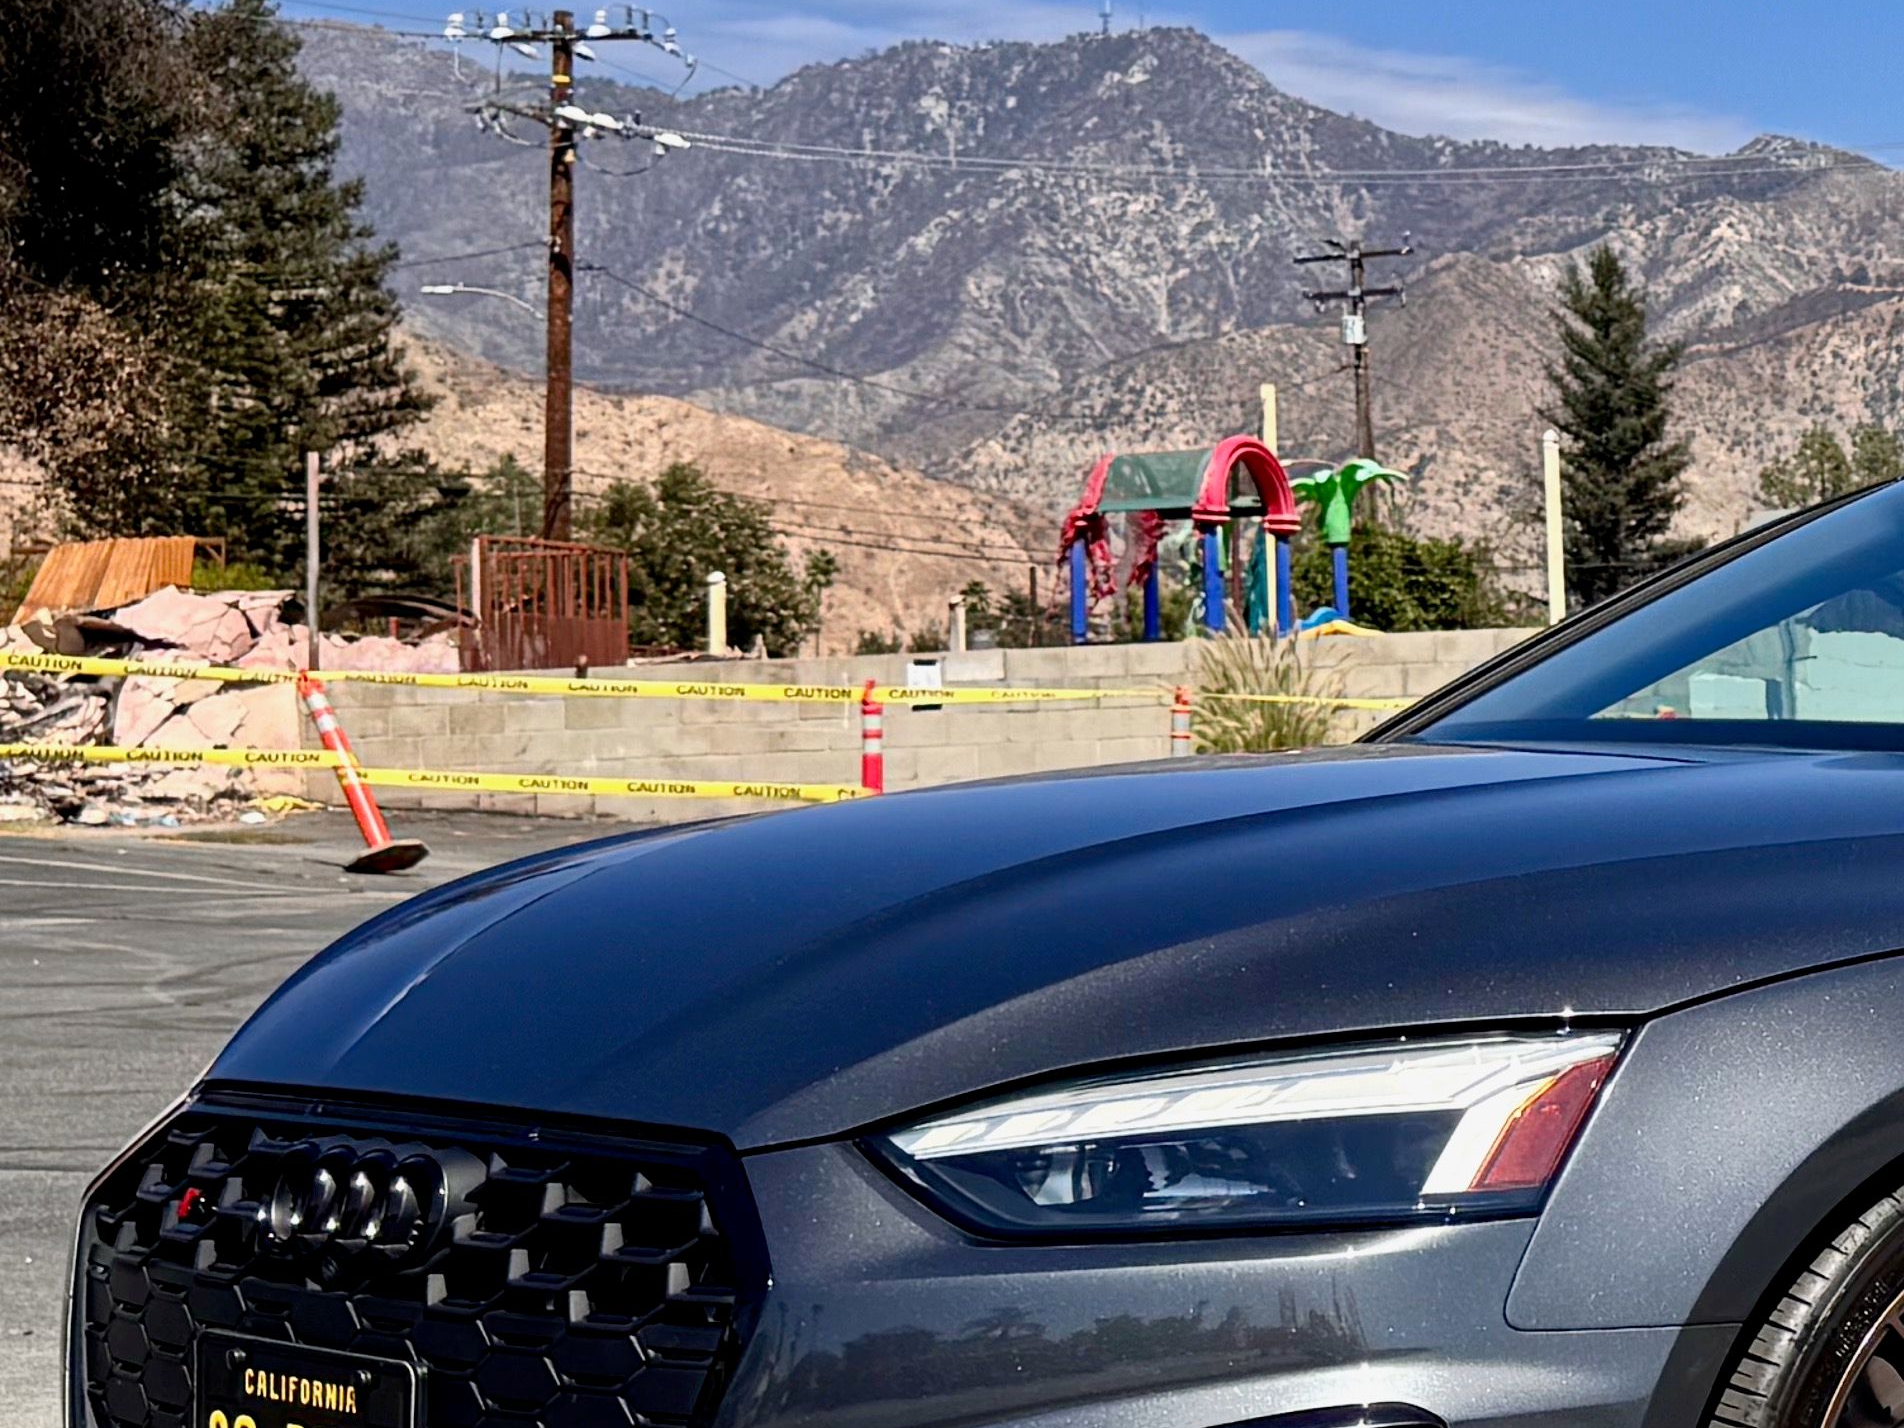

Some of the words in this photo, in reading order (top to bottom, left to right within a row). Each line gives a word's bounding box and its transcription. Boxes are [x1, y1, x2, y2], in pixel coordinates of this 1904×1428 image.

[7, 654, 83, 671] CAUTION
[676, 684, 746, 697] CAUTION
[783, 687, 853, 700] CAUTION
[888, 688, 955, 700] CAUTION
[125, 751, 204, 762] CAUTION
[244, 753, 321, 763] CAUTION
[408, 773, 480, 785] CAUTION
[518, 778, 589, 791] CAUTION
[626, 782, 696, 794] CAUTION
[733, 785, 801, 798] CAUTION
[245, 1367, 358, 1414] CALIFORNIA
